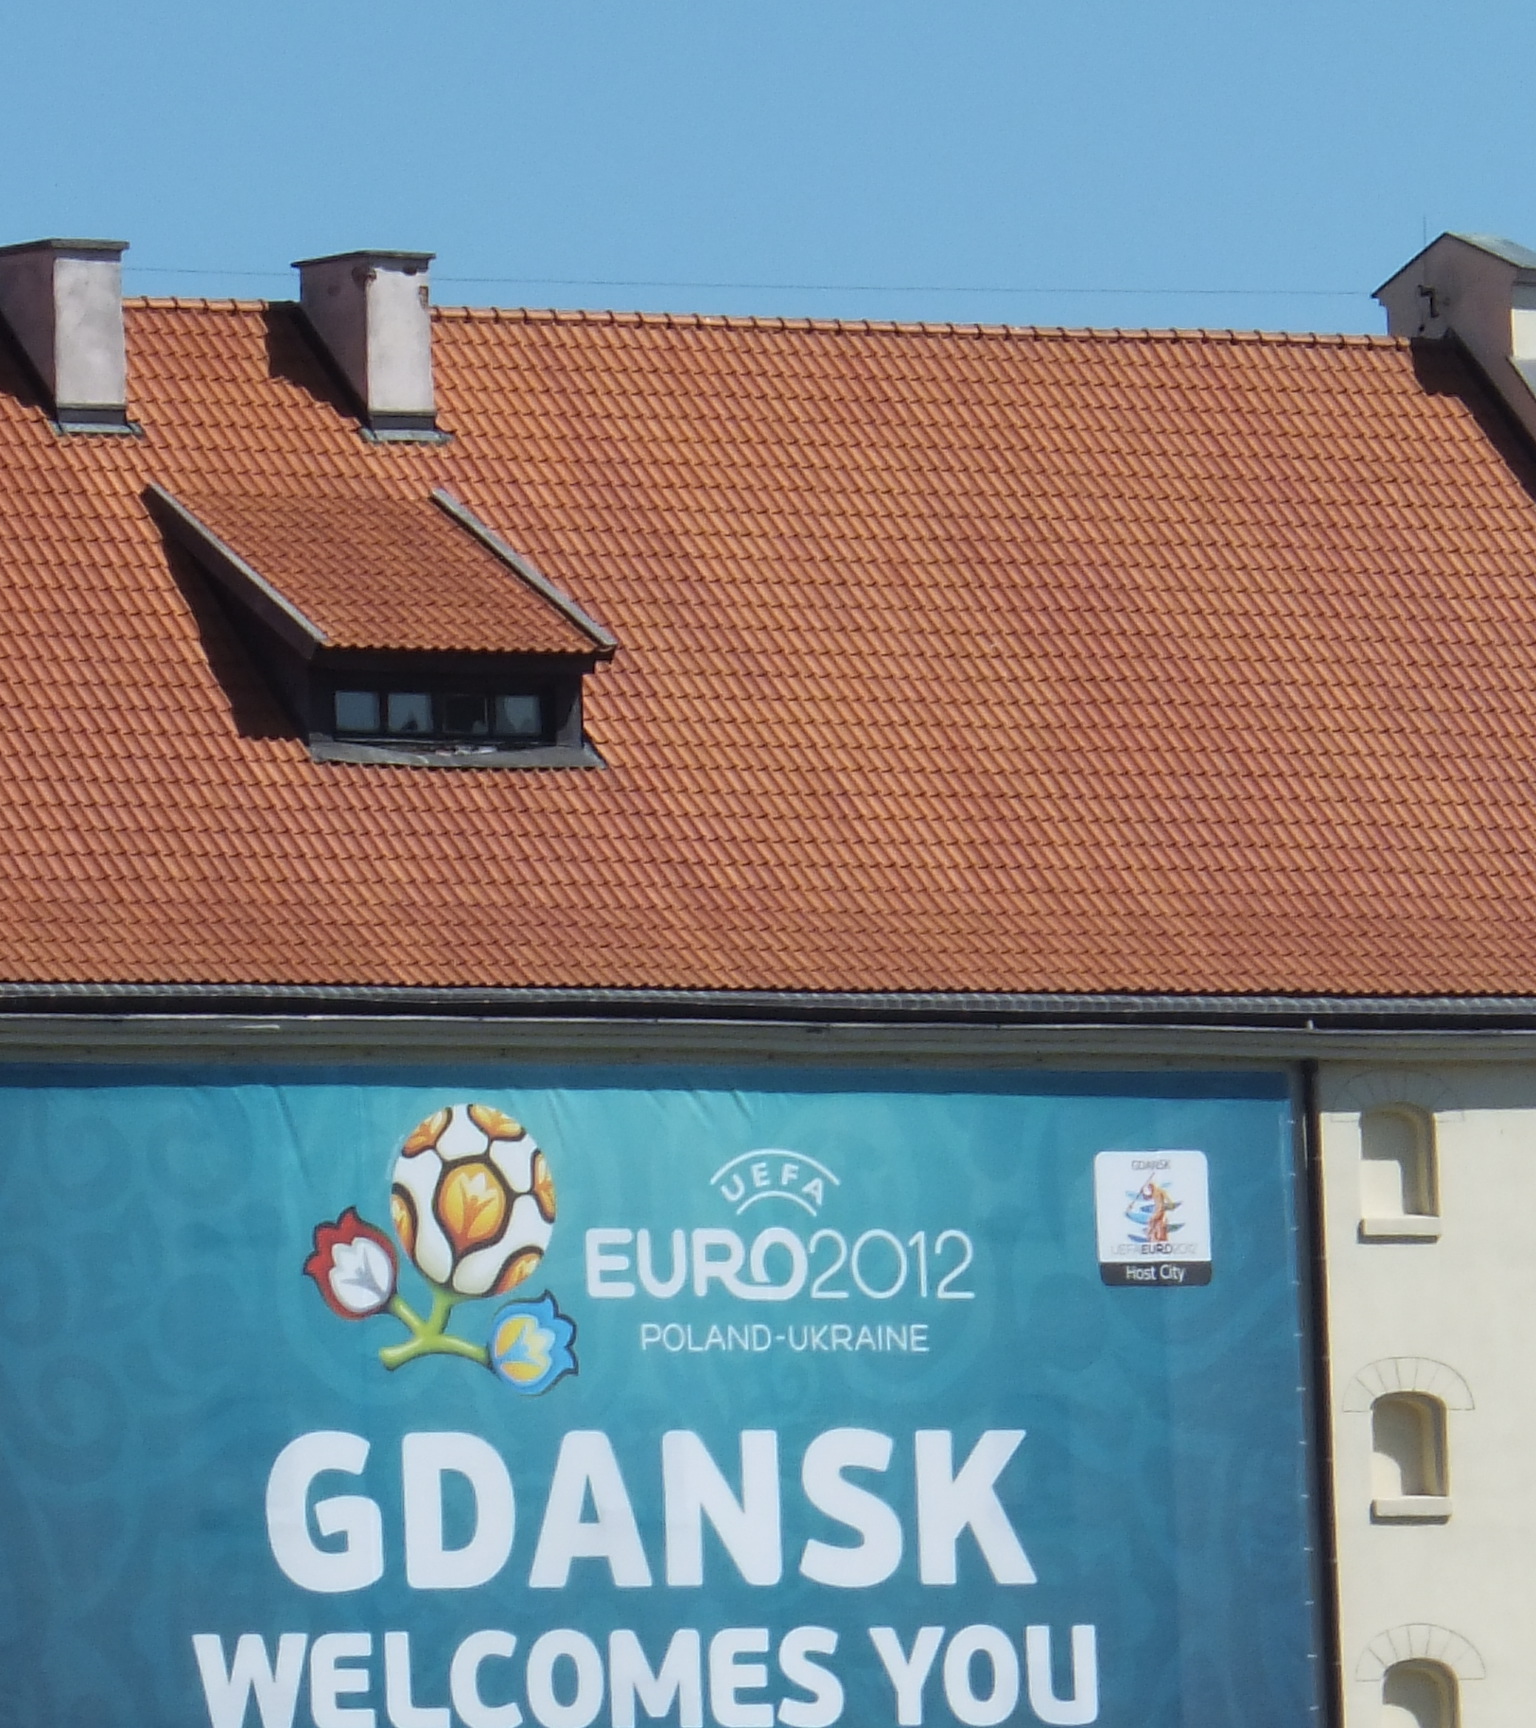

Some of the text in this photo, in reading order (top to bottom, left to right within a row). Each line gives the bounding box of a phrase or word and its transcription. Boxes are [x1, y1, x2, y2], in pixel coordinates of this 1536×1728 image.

[721, 1162, 823, 1205] UEFA
[1125, 1264, 1186, 1282] Host City
[640, 1323, 930, 1352] POLAND-UKRAINE
[266, 1428, 1037, 1592] GDANSK
[869, 1624, 1100, 1727] YOU
